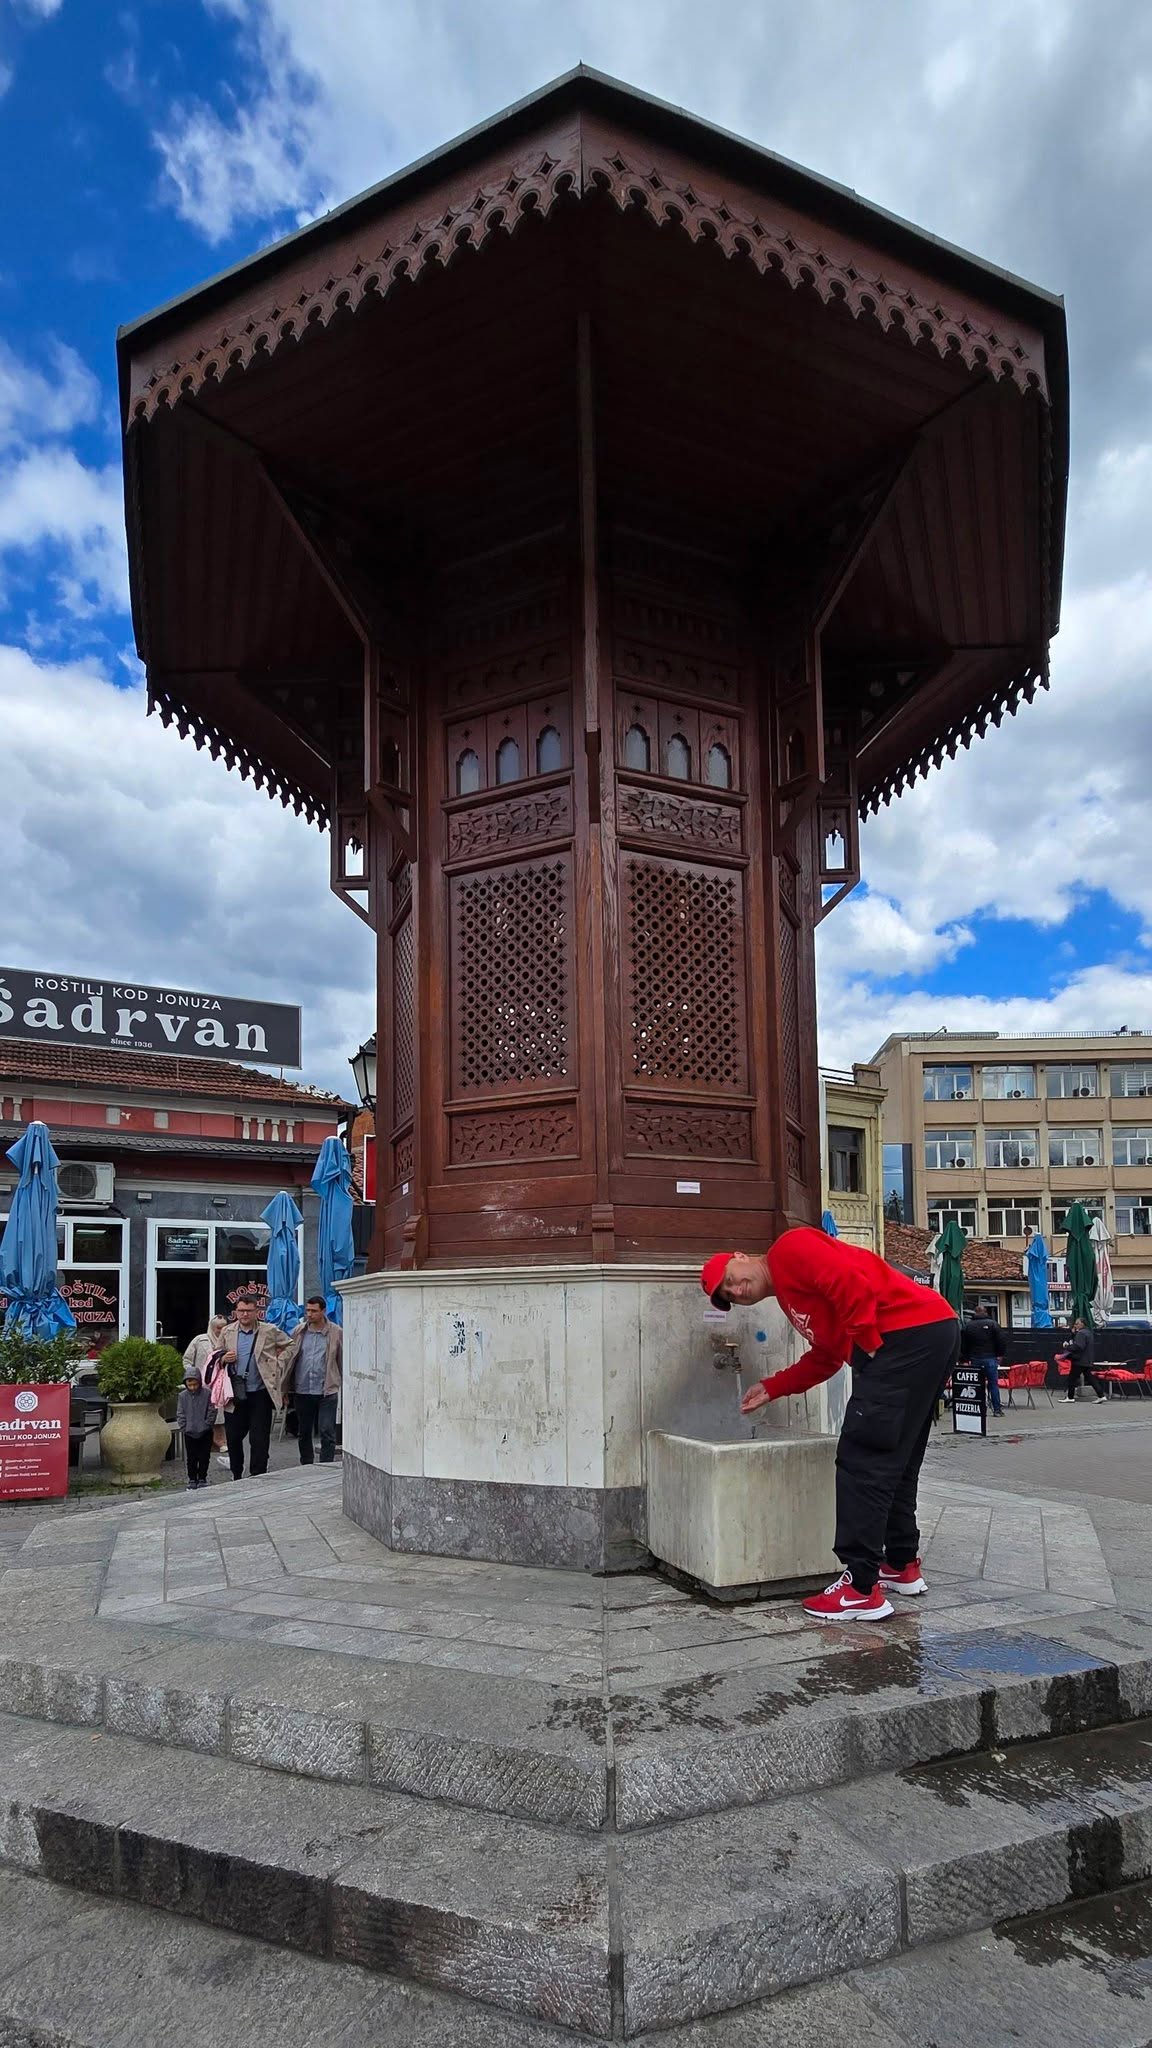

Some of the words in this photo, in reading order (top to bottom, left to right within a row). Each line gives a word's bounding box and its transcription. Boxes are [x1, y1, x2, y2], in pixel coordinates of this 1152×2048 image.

[34, 977, 104, 996] ROŠTILJ
[112, 987, 148, 1001] KOD
[156, 993, 222, 1011] JONUZA
[110, 1038, 132, 1047] since
[60, 1280, 117, 1305] OŠTILJ
[69, 1297, 93, 1308] kod
[72, 1311, 116, 1323] NUZA
[956, 1371, 979, 1382] CAFFE
[955, 1402, 981, 1413] PIZZERIA
[0, 1418, 61, 1431] adrvan
